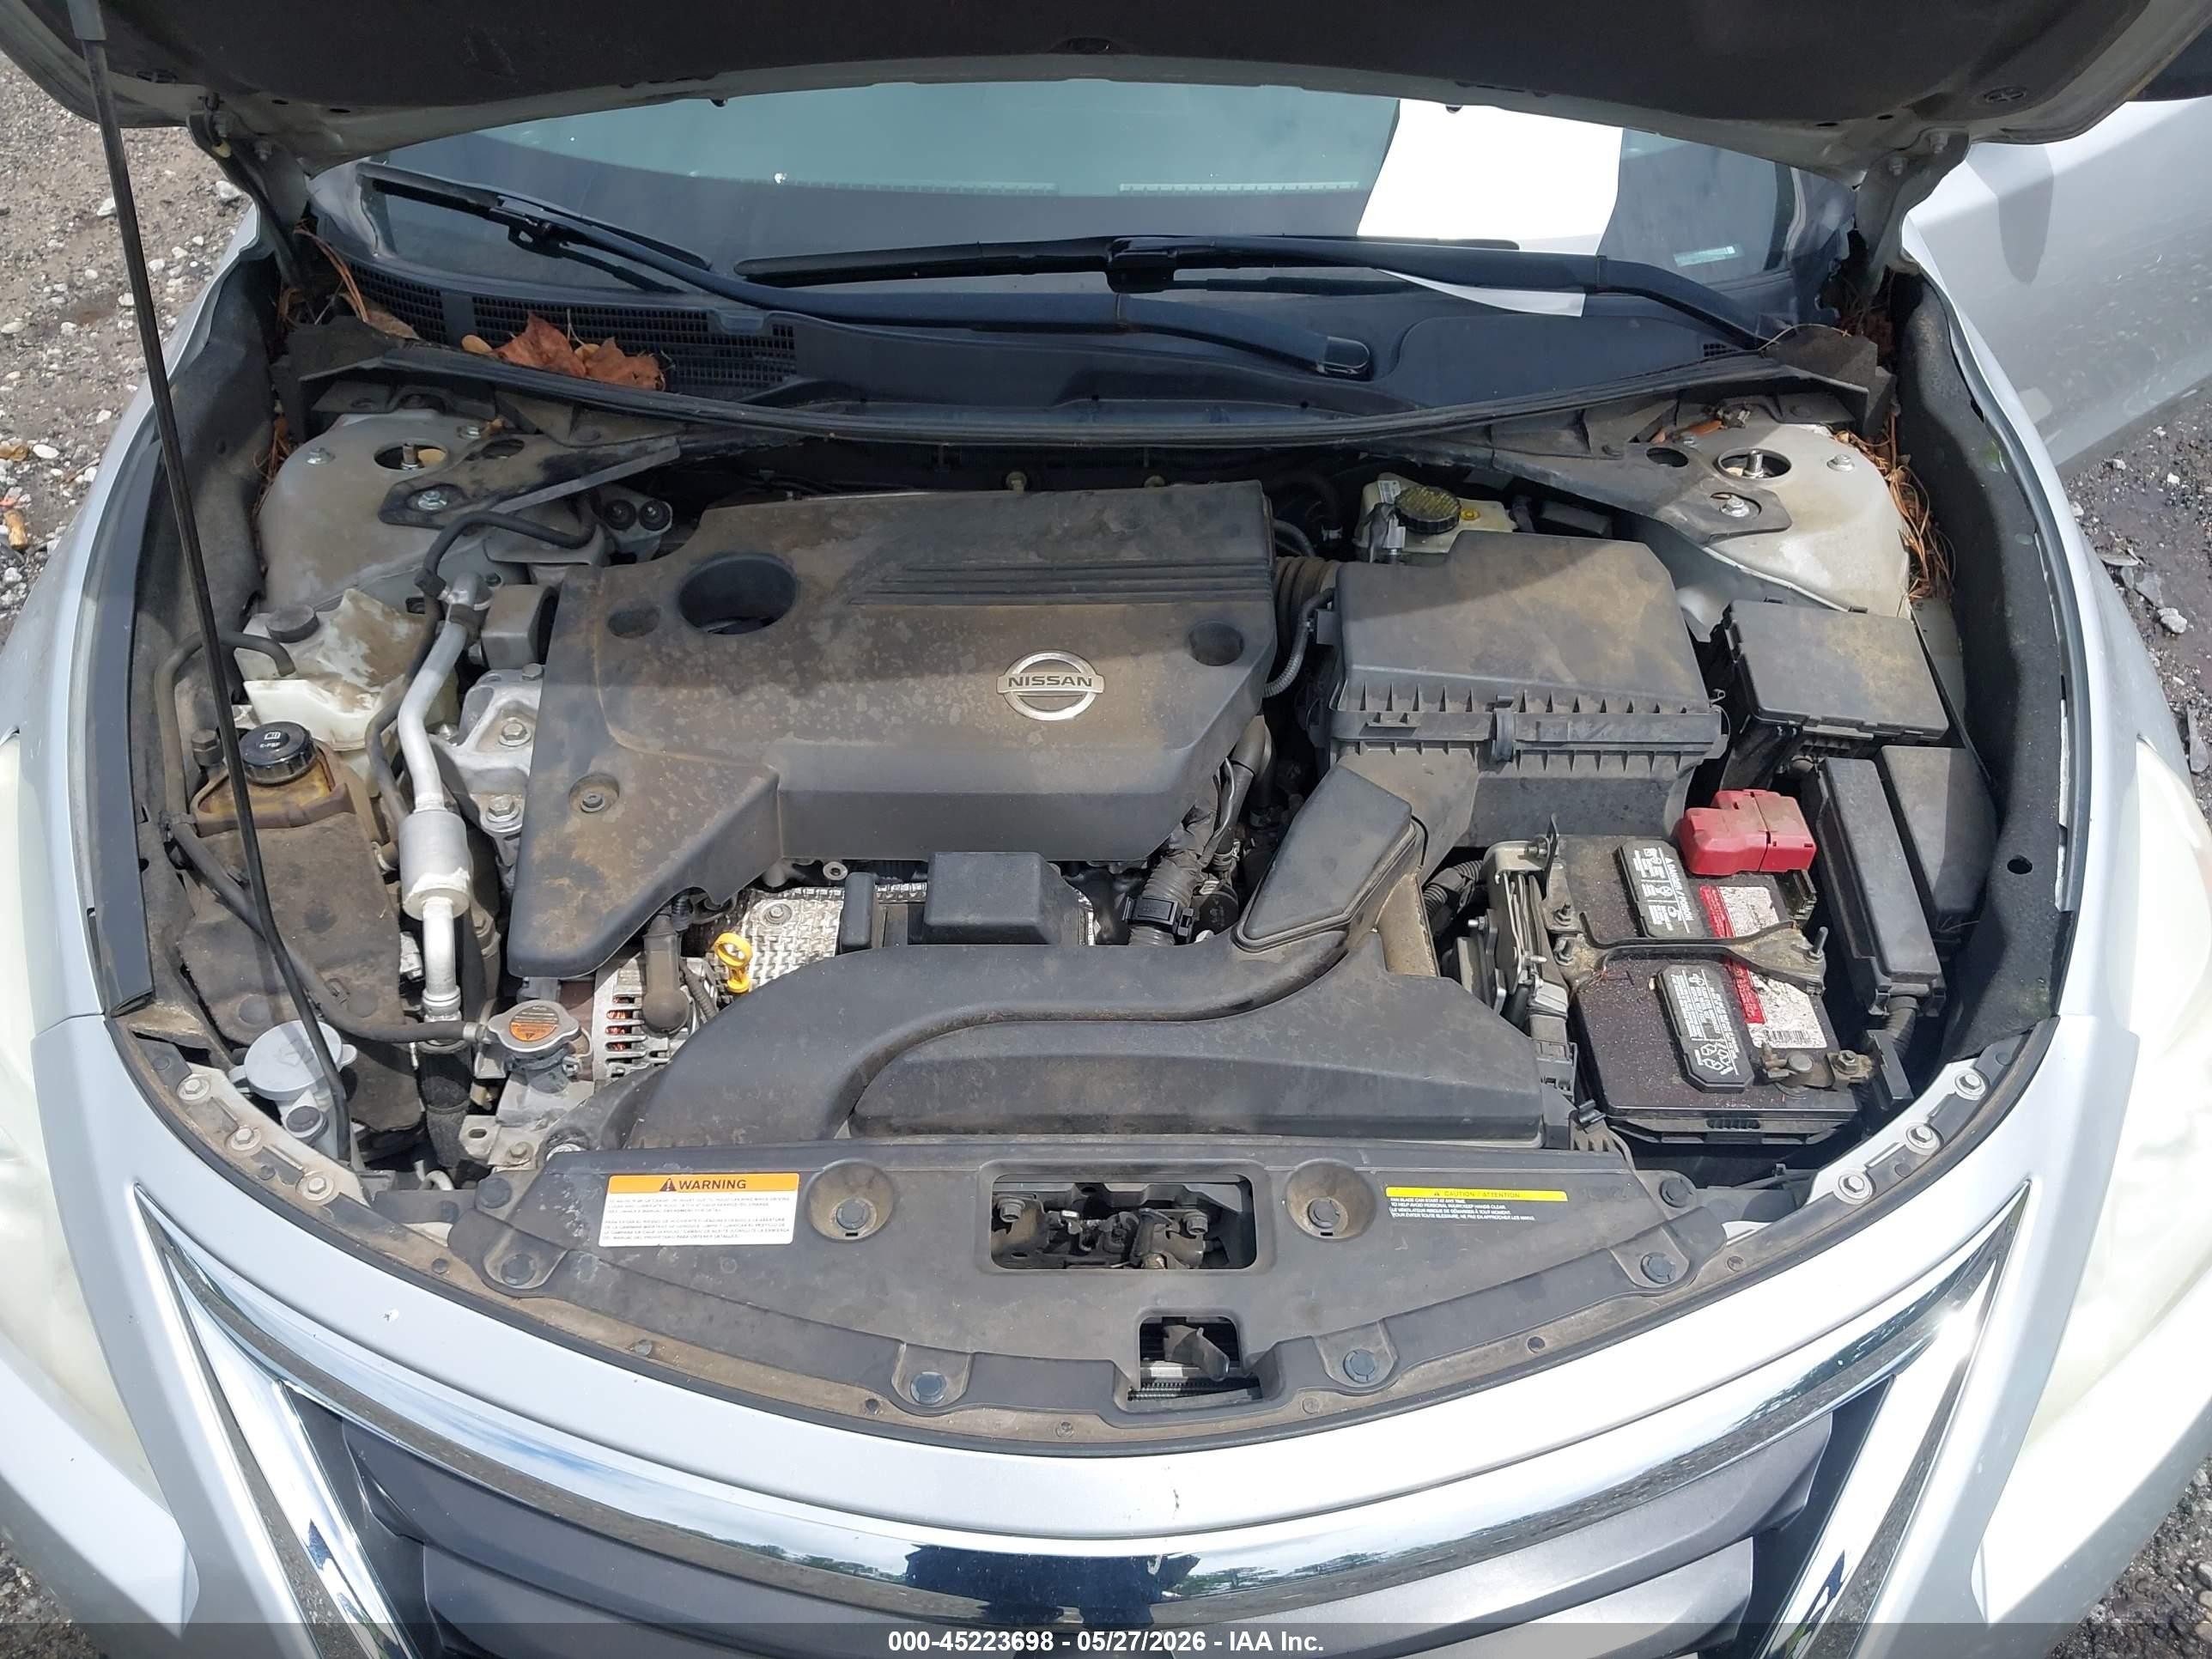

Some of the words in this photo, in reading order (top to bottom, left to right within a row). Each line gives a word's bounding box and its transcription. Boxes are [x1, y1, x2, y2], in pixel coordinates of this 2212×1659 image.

[1007, 675, 1093, 688] NISSAN
[1666, 864, 1683, 890] DANGER
[678, 1179, 747, 1191] WARNING
